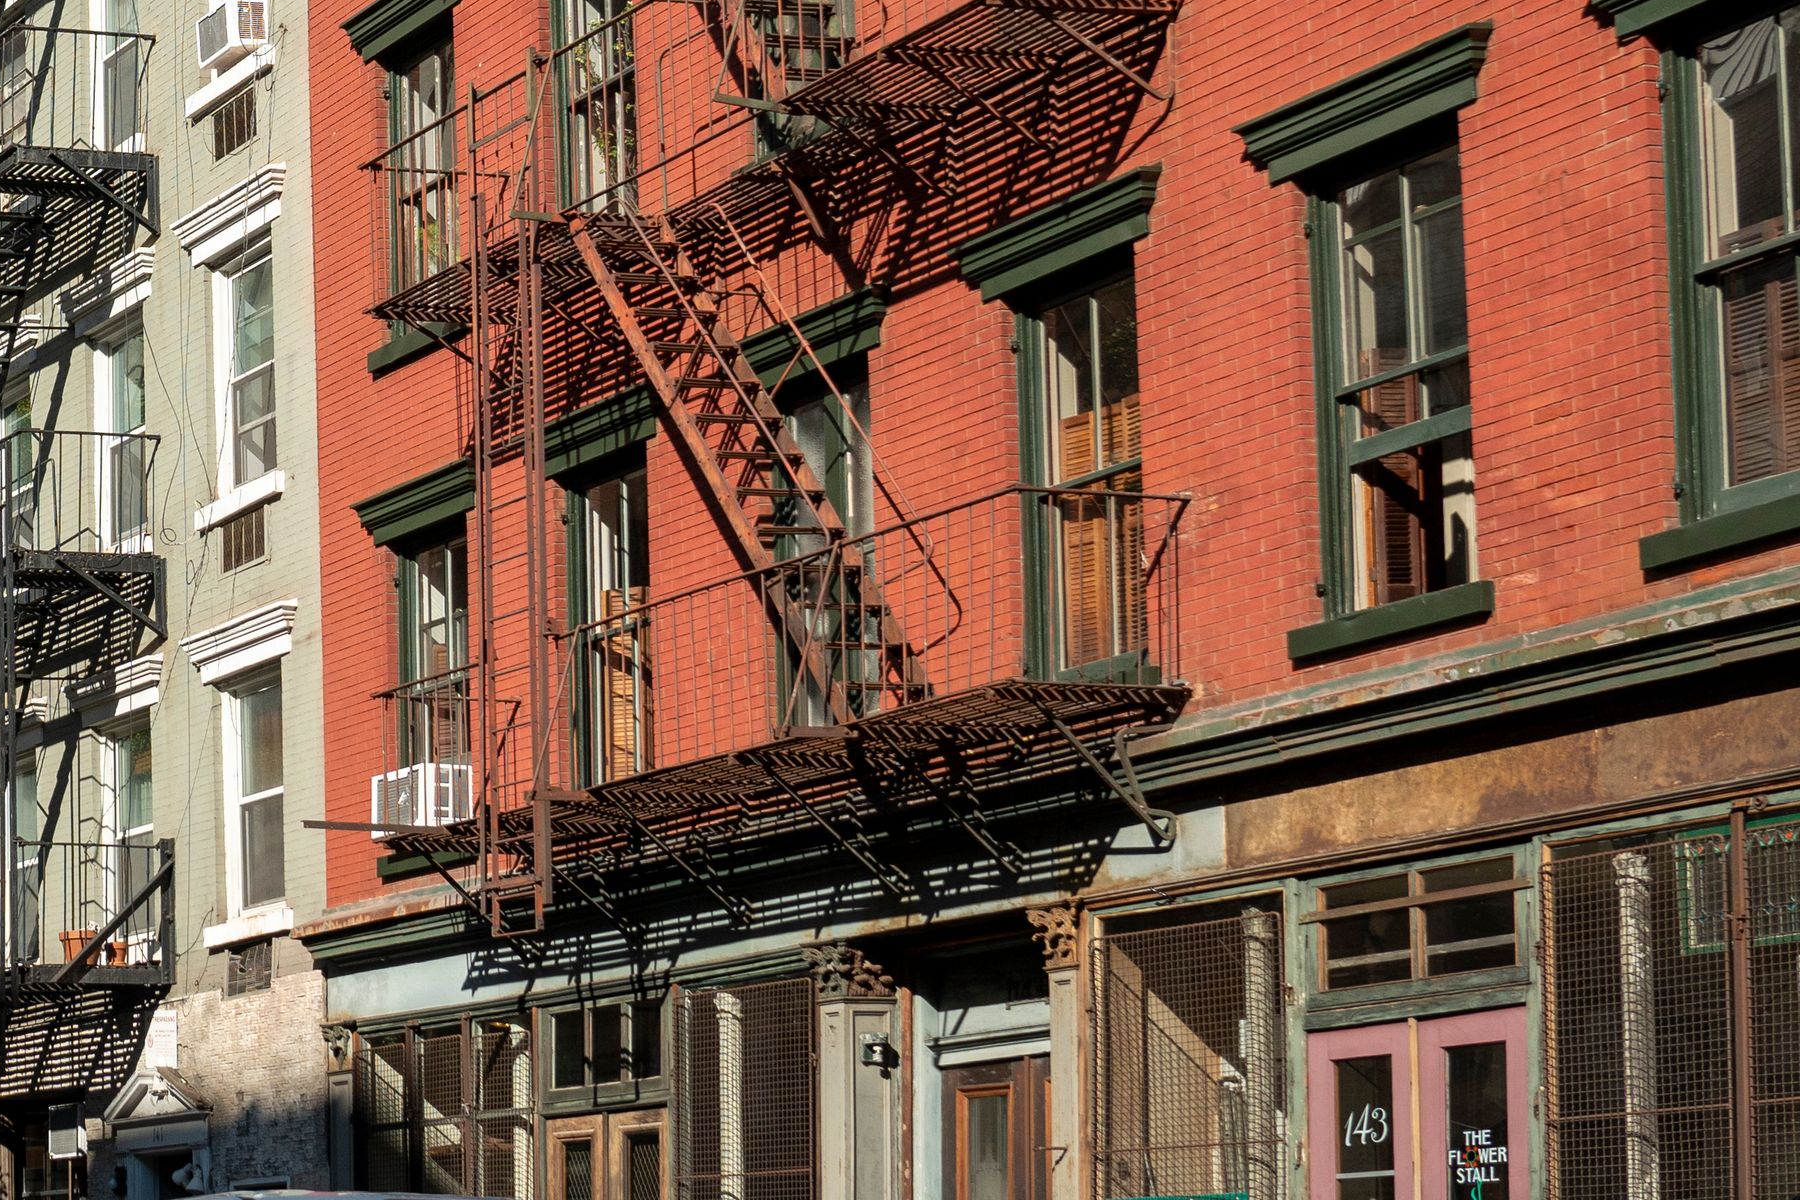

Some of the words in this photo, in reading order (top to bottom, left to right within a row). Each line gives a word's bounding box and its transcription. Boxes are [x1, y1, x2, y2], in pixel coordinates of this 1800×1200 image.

[1344, 1103, 1389, 1147] 143
[1463, 1129, 1492, 1146] THE
[1448, 1146, 1508, 1167] FLOWER
[1456, 1166, 1500, 1184] STALL
